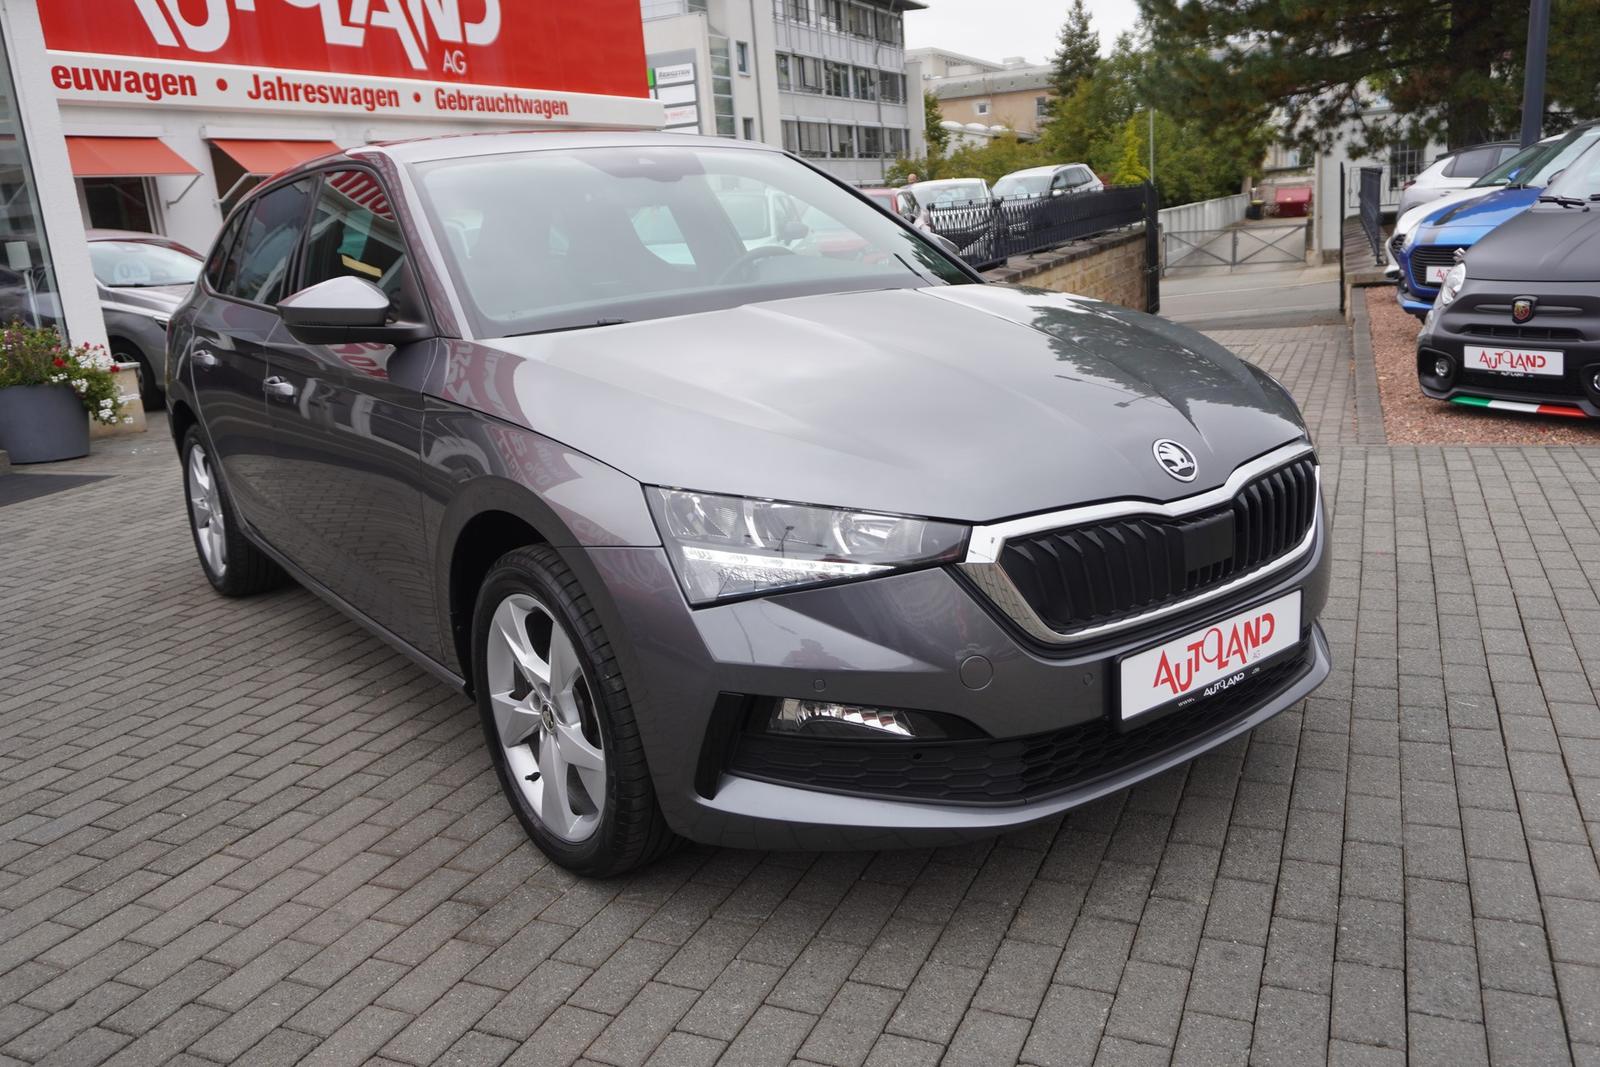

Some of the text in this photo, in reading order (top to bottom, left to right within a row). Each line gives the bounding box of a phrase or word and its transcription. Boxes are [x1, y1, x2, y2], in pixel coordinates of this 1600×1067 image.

[132, 0, 501, 71] ULAND
[443, 50, 468, 75] AG
[247, 74, 400, 112] Jahreswagen
[434, 87, 569, 119] Gebrauchtwagen
[1479, 350, 1547, 371] AUTOLAND
[1153, 612, 1275, 695] AUTOLAND
[1203, 672, 1245, 697] AUTOLAND
